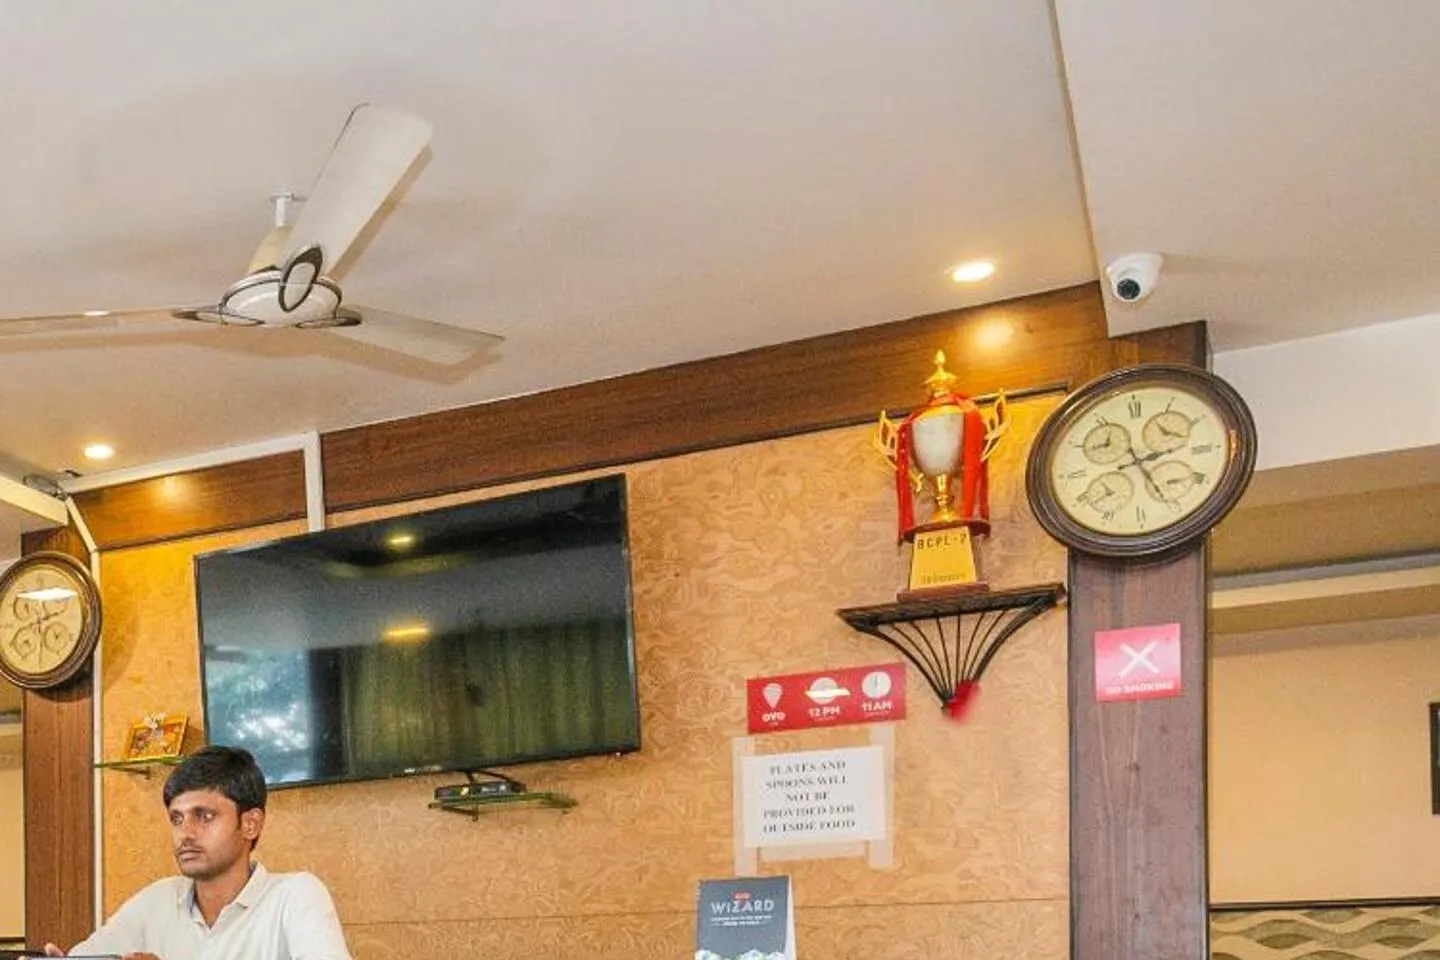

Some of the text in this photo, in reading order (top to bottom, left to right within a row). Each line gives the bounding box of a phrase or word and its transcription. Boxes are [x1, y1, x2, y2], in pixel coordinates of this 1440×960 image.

[820, 761, 846, 771] AND
[786, 792, 811, 801] NOT
[763, 806, 827, 818] PROVIDED
[819, 819, 855, 830] FOOD
[710, 898, 775, 914] WIZARD
